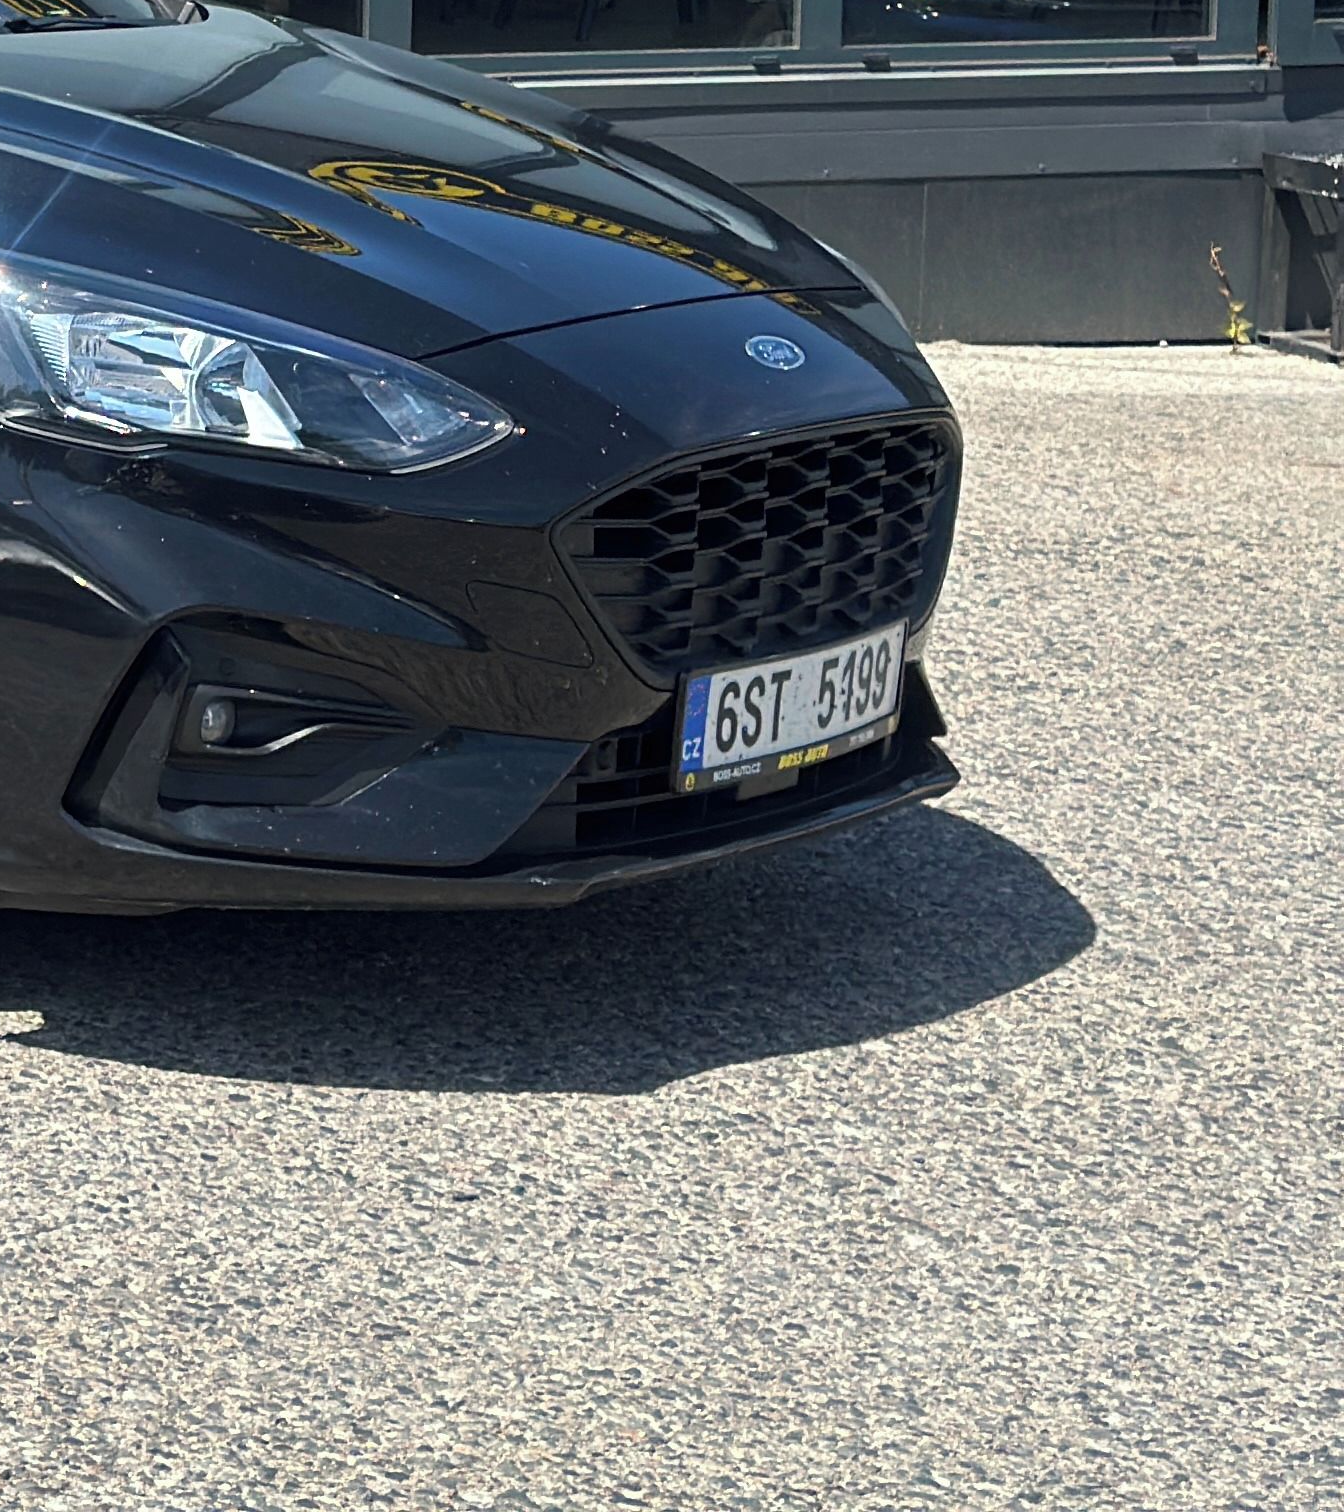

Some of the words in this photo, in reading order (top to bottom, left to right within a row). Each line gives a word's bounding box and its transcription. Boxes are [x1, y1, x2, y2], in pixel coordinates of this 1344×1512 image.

[715, 669, 792, 753] 6ST
[817, 638, 892, 729] 5199
[682, 737, 702, 761] CZ
